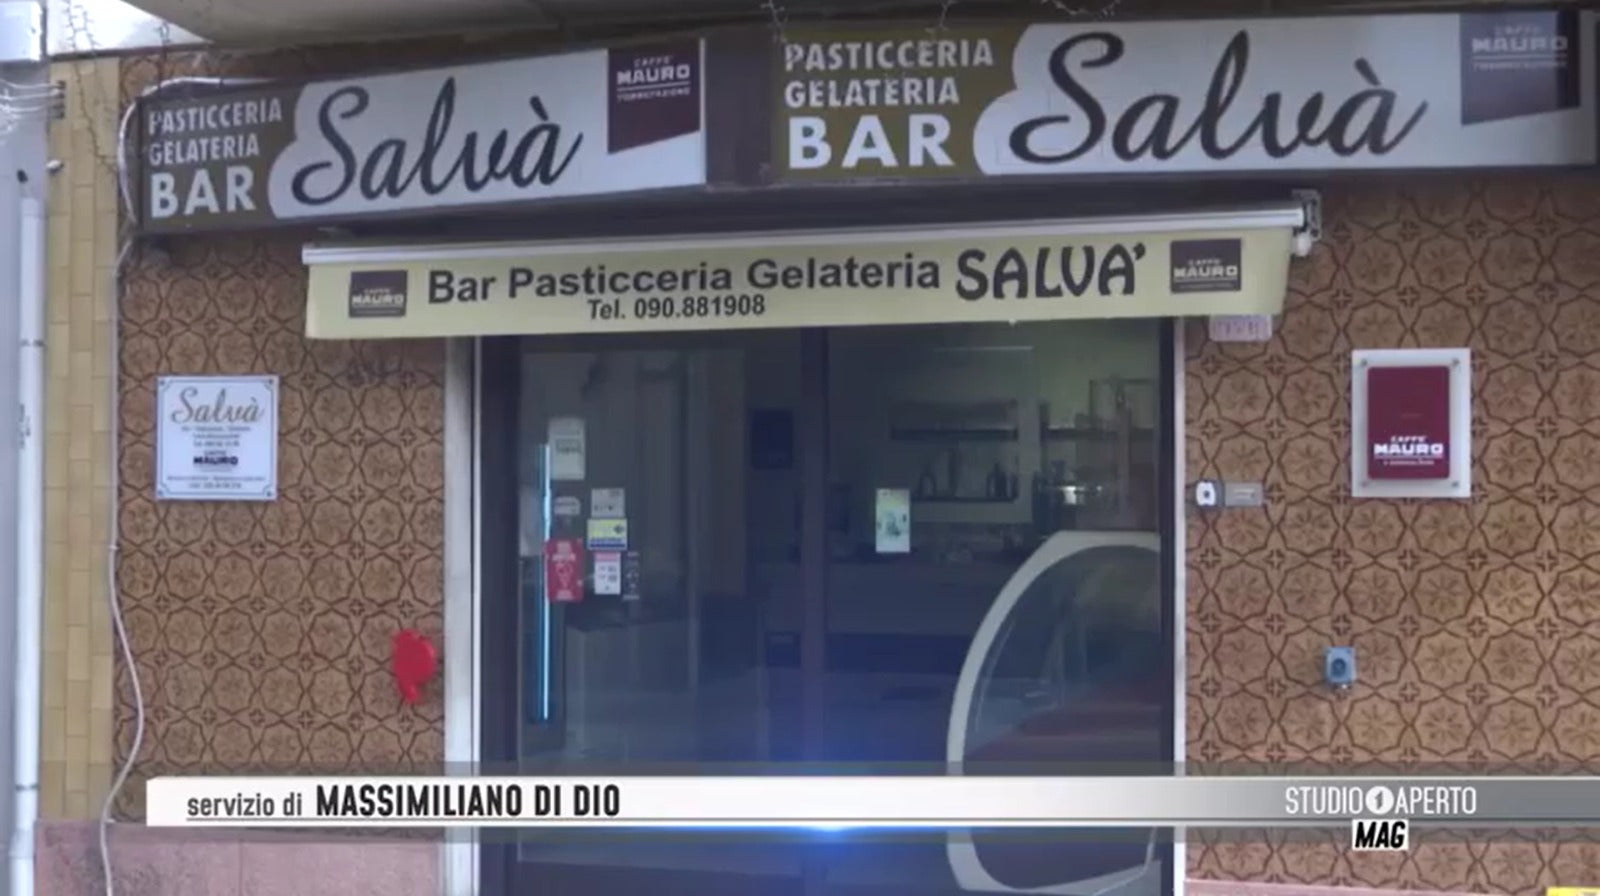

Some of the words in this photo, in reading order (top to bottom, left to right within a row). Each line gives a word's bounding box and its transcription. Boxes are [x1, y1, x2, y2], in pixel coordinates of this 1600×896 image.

[784, 39, 993, 71] PASTICCERIA
[1472, 37, 1567, 52] MAURO
[617, 64, 690, 85] MAURO
[784, 76, 959, 108] GELATERIA
[1009, 30, 1428, 164] Salvà
[149, 98, 282, 134] PASTICCERIA
[150, 133, 260, 166] GELATERIA
[291, 76, 583, 205] Salvà
[788, 113, 955, 169] BAR
[151, 165, 256, 218] BAR
[428, 269, 496, 304] Bar
[508, 262, 732, 299] Pasticceria
[747, 252, 940, 290] Gelateria
[1174, 265, 1238, 277] MAURO
[587, 299, 626, 320] Tel.
[634, 294, 766, 319] 090.881908
[170, 386, 265, 424] Salvà
[1374, 443, 1444, 454] MAURO
